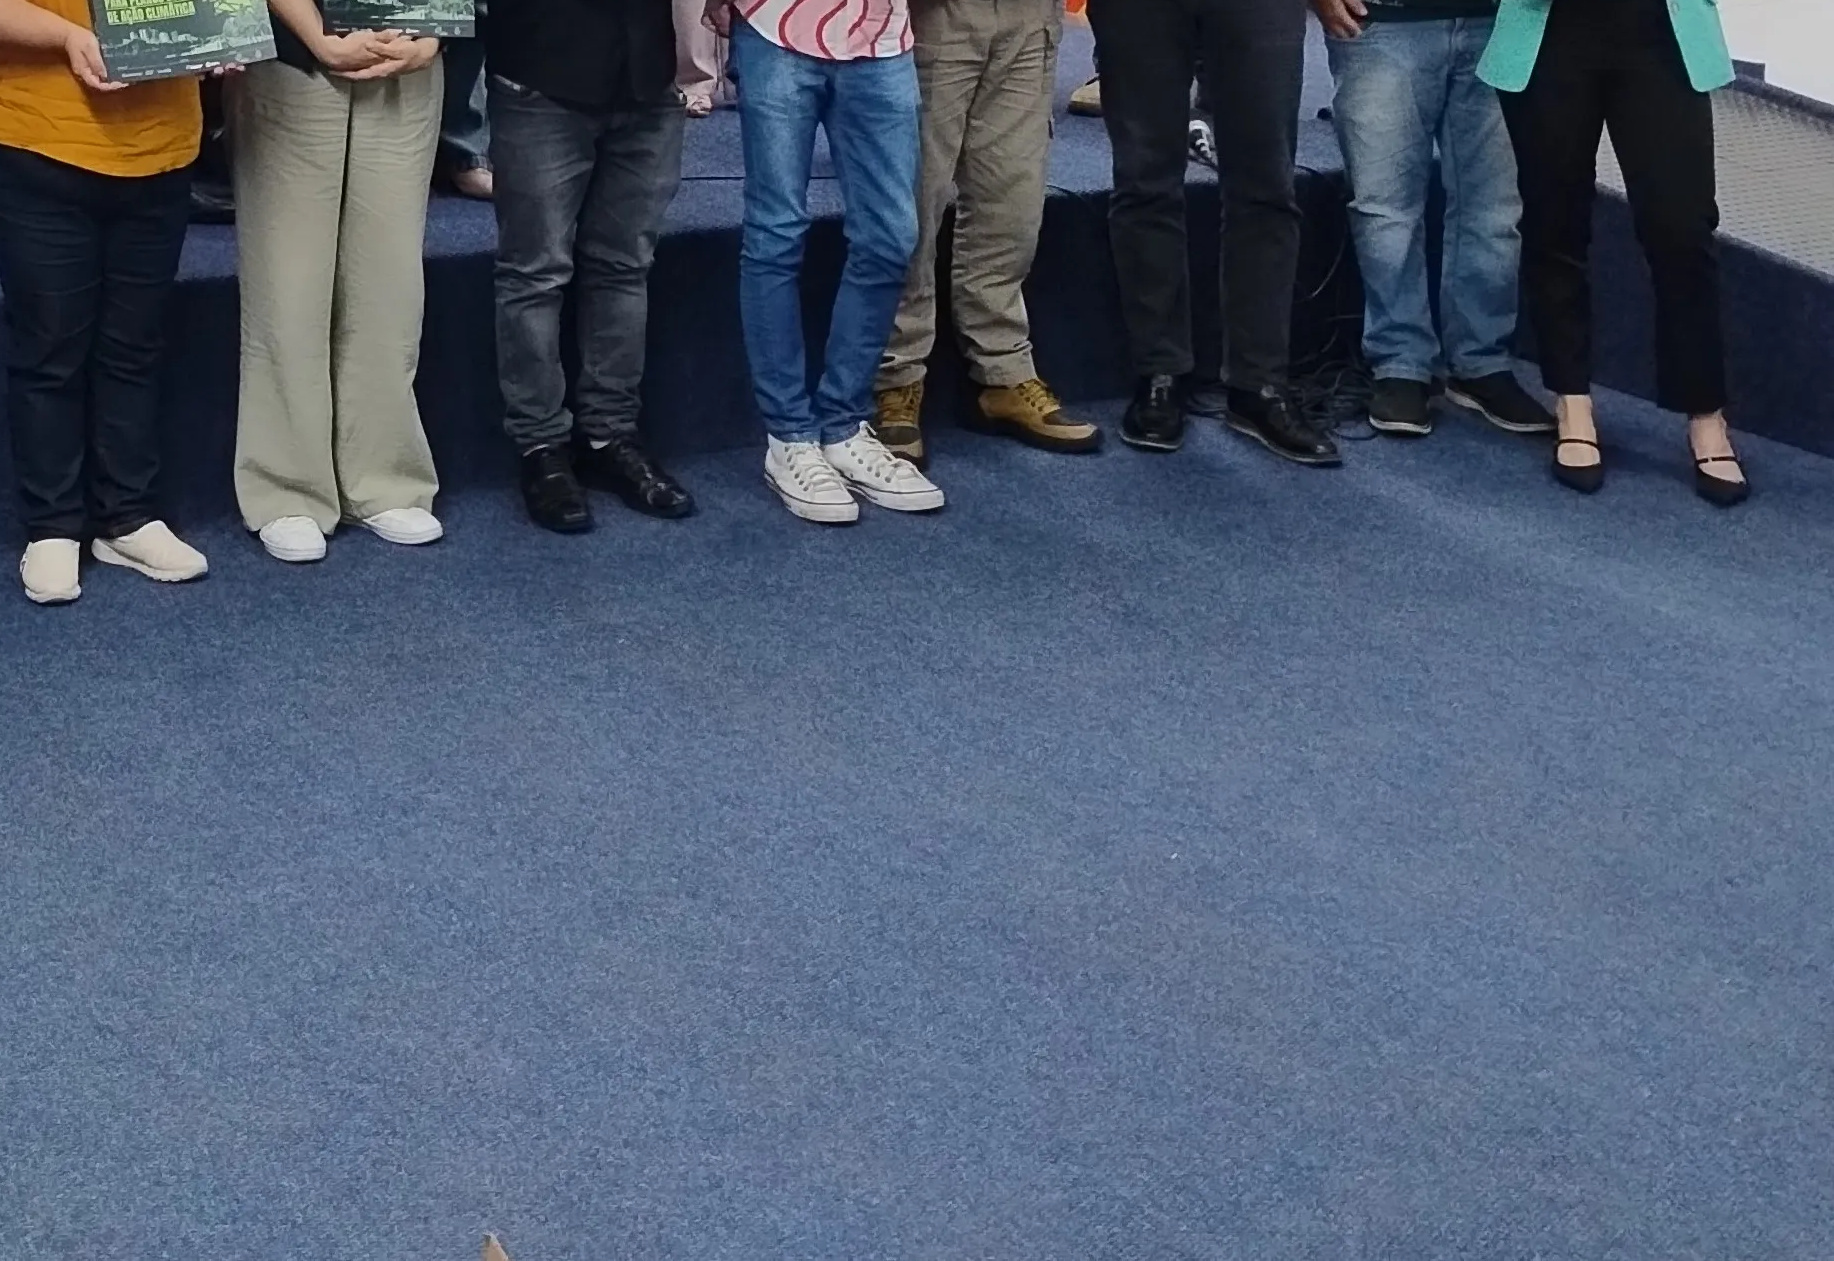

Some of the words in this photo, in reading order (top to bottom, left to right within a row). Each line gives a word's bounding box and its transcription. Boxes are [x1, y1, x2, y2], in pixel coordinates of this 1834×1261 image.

[106, 11, 120, 23] DE
[119, 6, 146, 26] AÇÃO
[145, 0, 195, 20] CLIMÁTICA
